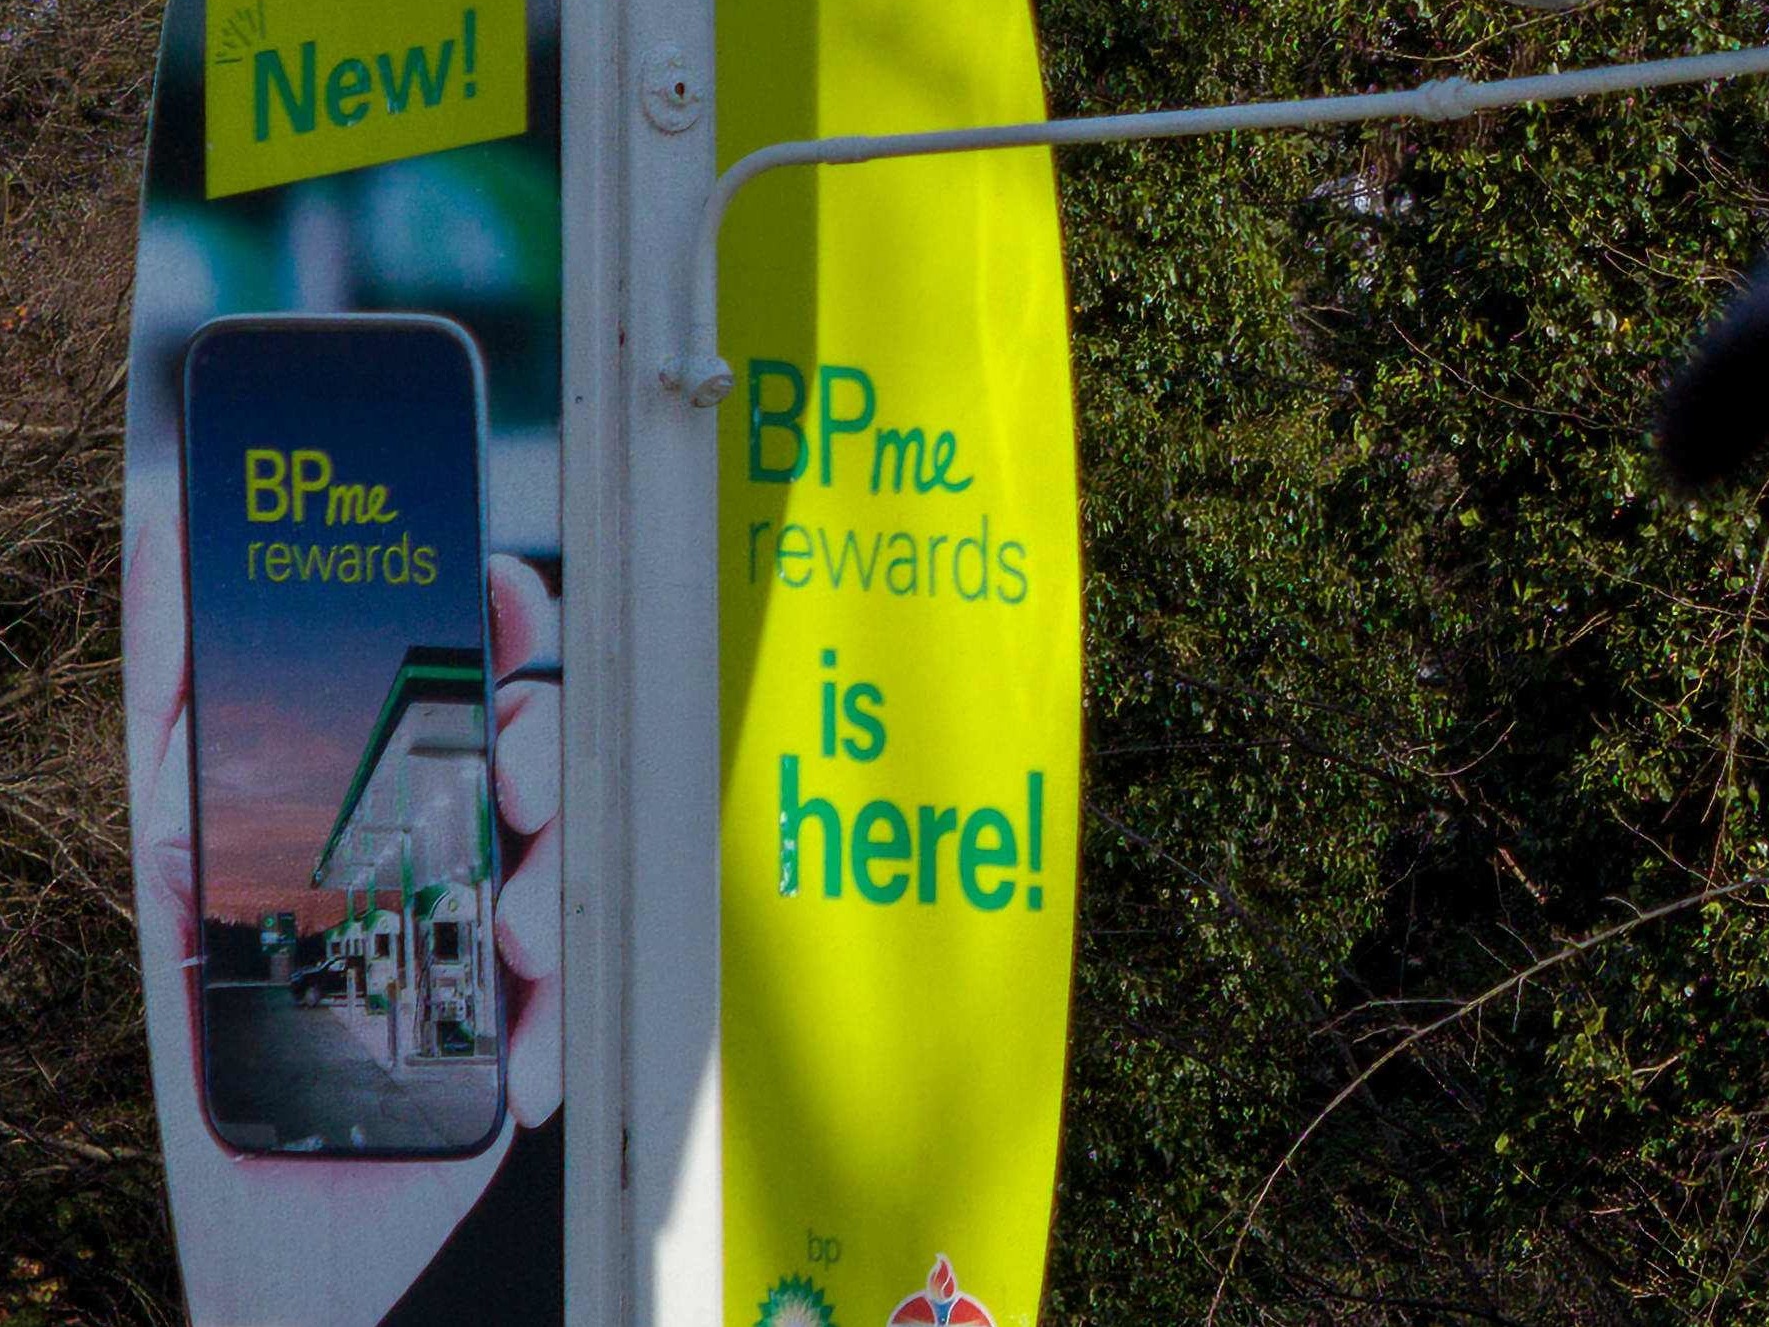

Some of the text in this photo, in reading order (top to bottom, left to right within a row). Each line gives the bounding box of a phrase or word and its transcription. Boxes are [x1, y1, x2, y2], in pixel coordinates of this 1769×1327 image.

[252, 8, 480, 143] New!
[246, 533, 440, 586] rewards
[746, 514, 1030, 606] rewards
[821, 649, 887, 762] is
[779, 754, 1044, 911] here!
[806, 1229, 841, 1268] bp
